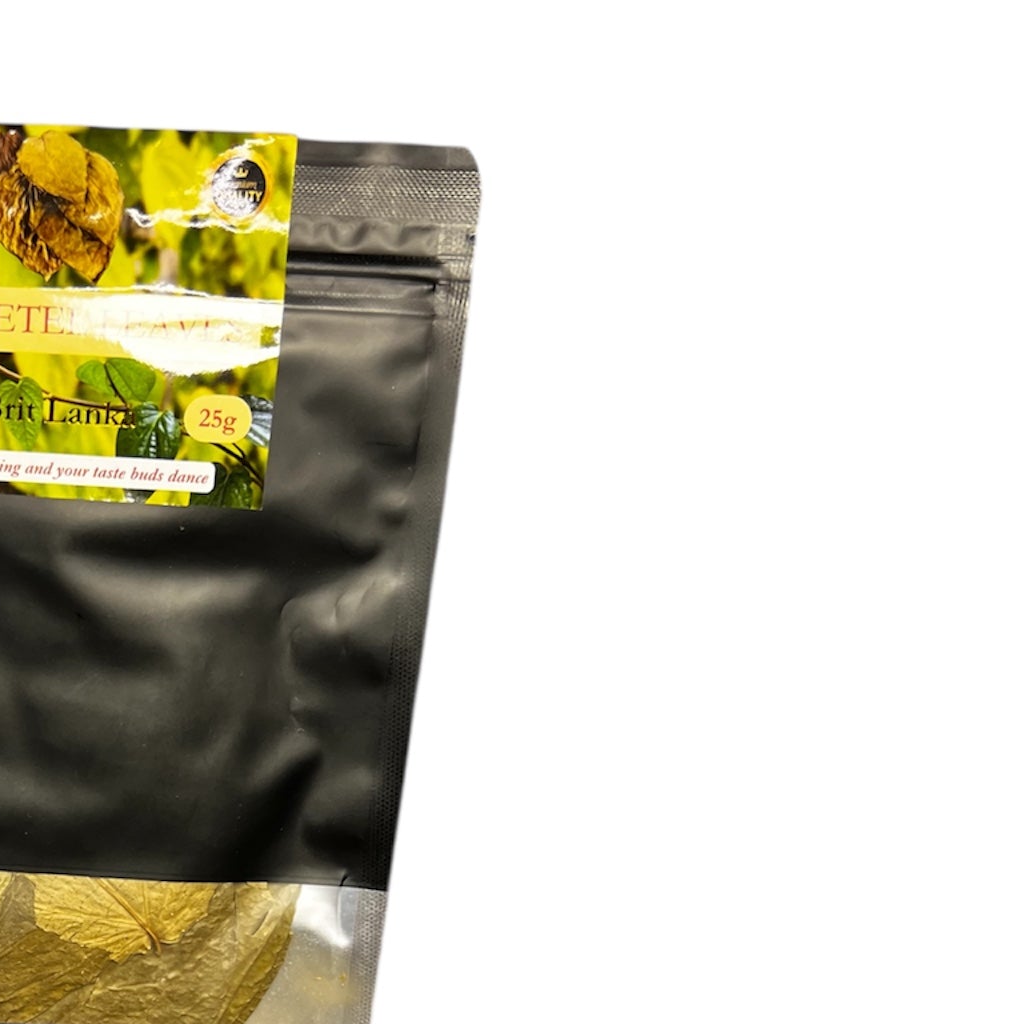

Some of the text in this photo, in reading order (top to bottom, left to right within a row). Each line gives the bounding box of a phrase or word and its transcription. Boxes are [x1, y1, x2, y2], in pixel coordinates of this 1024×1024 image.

[43, 397, 136, 428] Lanka
[199, 408, 237, 435] 25g
[25, 462, 54, 475] and
[53, 466, 90, 480] your
[92, 464, 126, 480] taste
[130, 467, 164, 482] buds
[167, 470, 209, 484] dance
